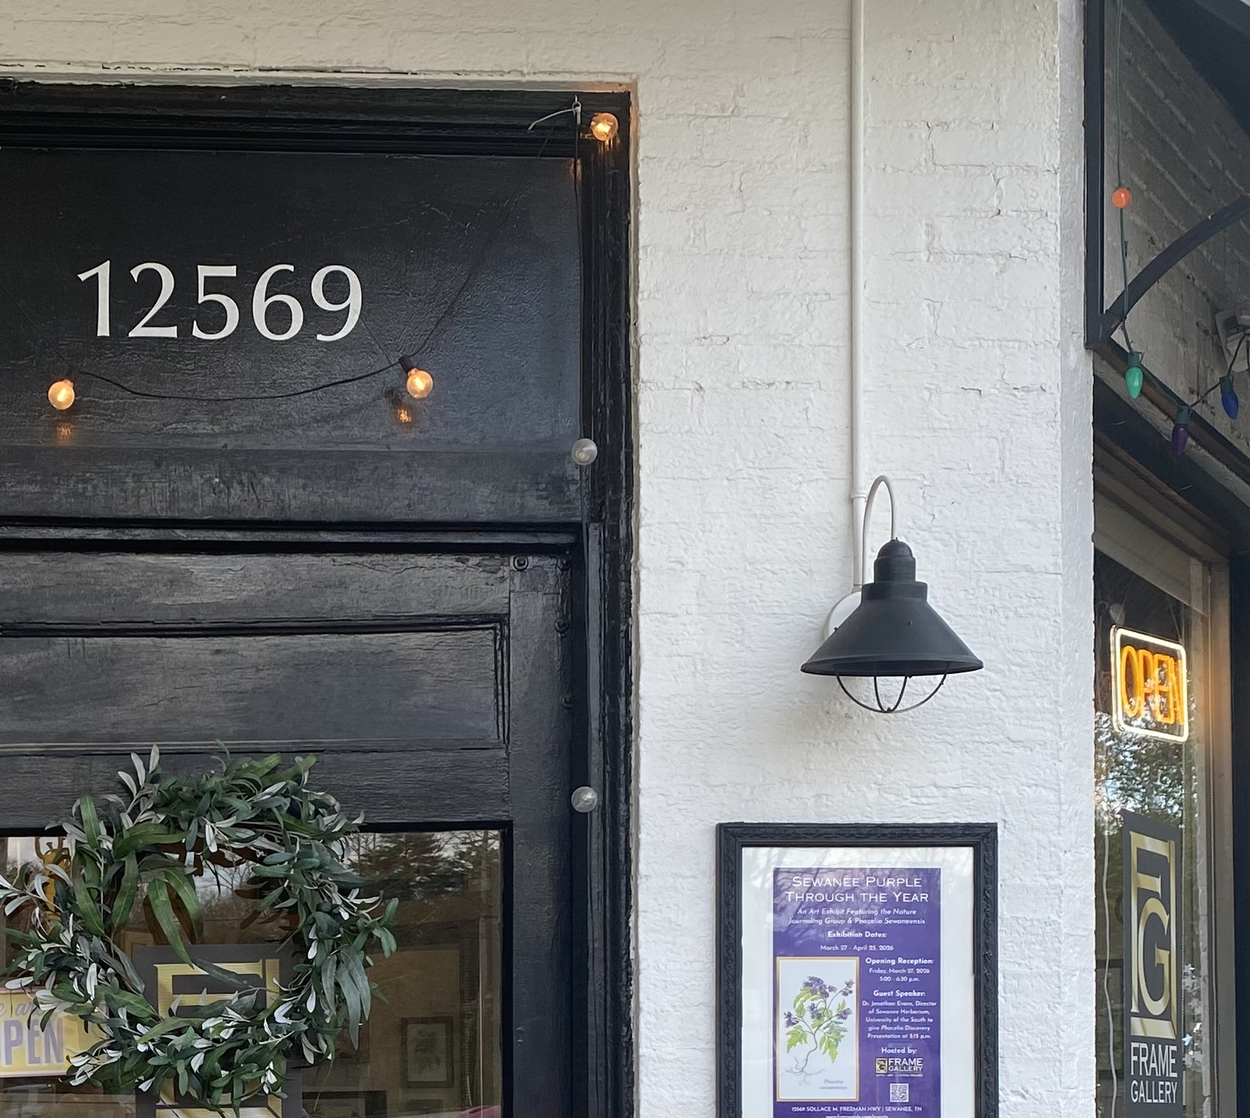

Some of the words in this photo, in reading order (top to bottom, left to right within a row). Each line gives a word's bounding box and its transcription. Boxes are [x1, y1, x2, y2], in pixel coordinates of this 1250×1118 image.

[77, 260, 362, 342] 12569
[1121, 644, 1184, 725] OPEN
[792, 876, 860, 888] SEWANEE
[866, 876, 922, 888] PURPLE
[785, 891, 855, 903] THROUGH
[860, 892, 888, 903] THE
[893, 891, 929, 903] YEAR
[846, 908, 879, 916] Featuring
[827, 930, 863, 938] Exhibition
[865, 930, 887, 938] Dates:
[865, 957, 896, 965] Opening
[898, 957, 934, 965] Reception:
[895, 989, 926, 997] Speaker:
[881, 1046, 906, 1054] Hosted
[907, 1046, 918, 1055] by:
[888, 1057, 923, 1066] FRAME
[1130, 1042, 1178, 1078] FRAME
[1130, 1080, 1178, 1104] GALLERY
